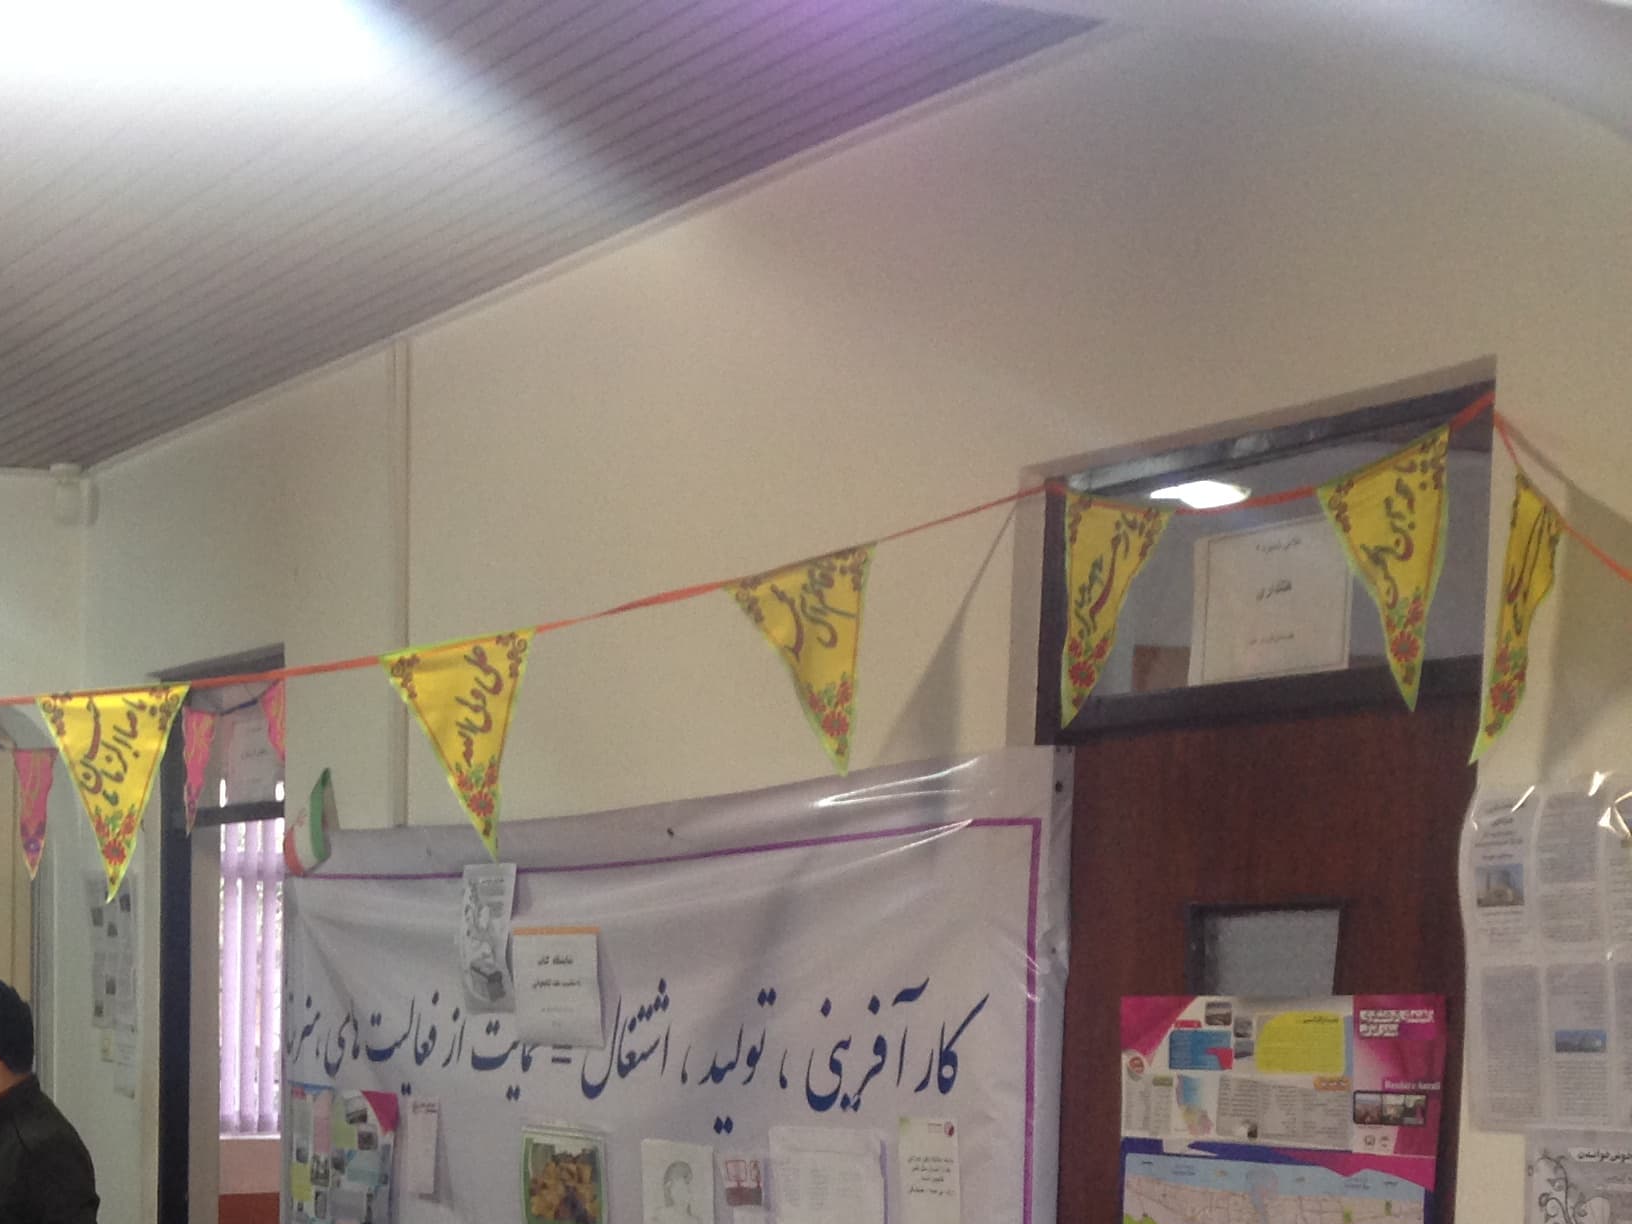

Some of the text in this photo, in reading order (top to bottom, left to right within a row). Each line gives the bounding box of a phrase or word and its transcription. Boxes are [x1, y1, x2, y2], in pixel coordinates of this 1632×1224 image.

[322, 1001, 360, 1079] های
[364, 989, 441, 1096] فعالیت
[441, 1007, 466, 1069] از
[580, 978, 672, 1101] اشتغال
